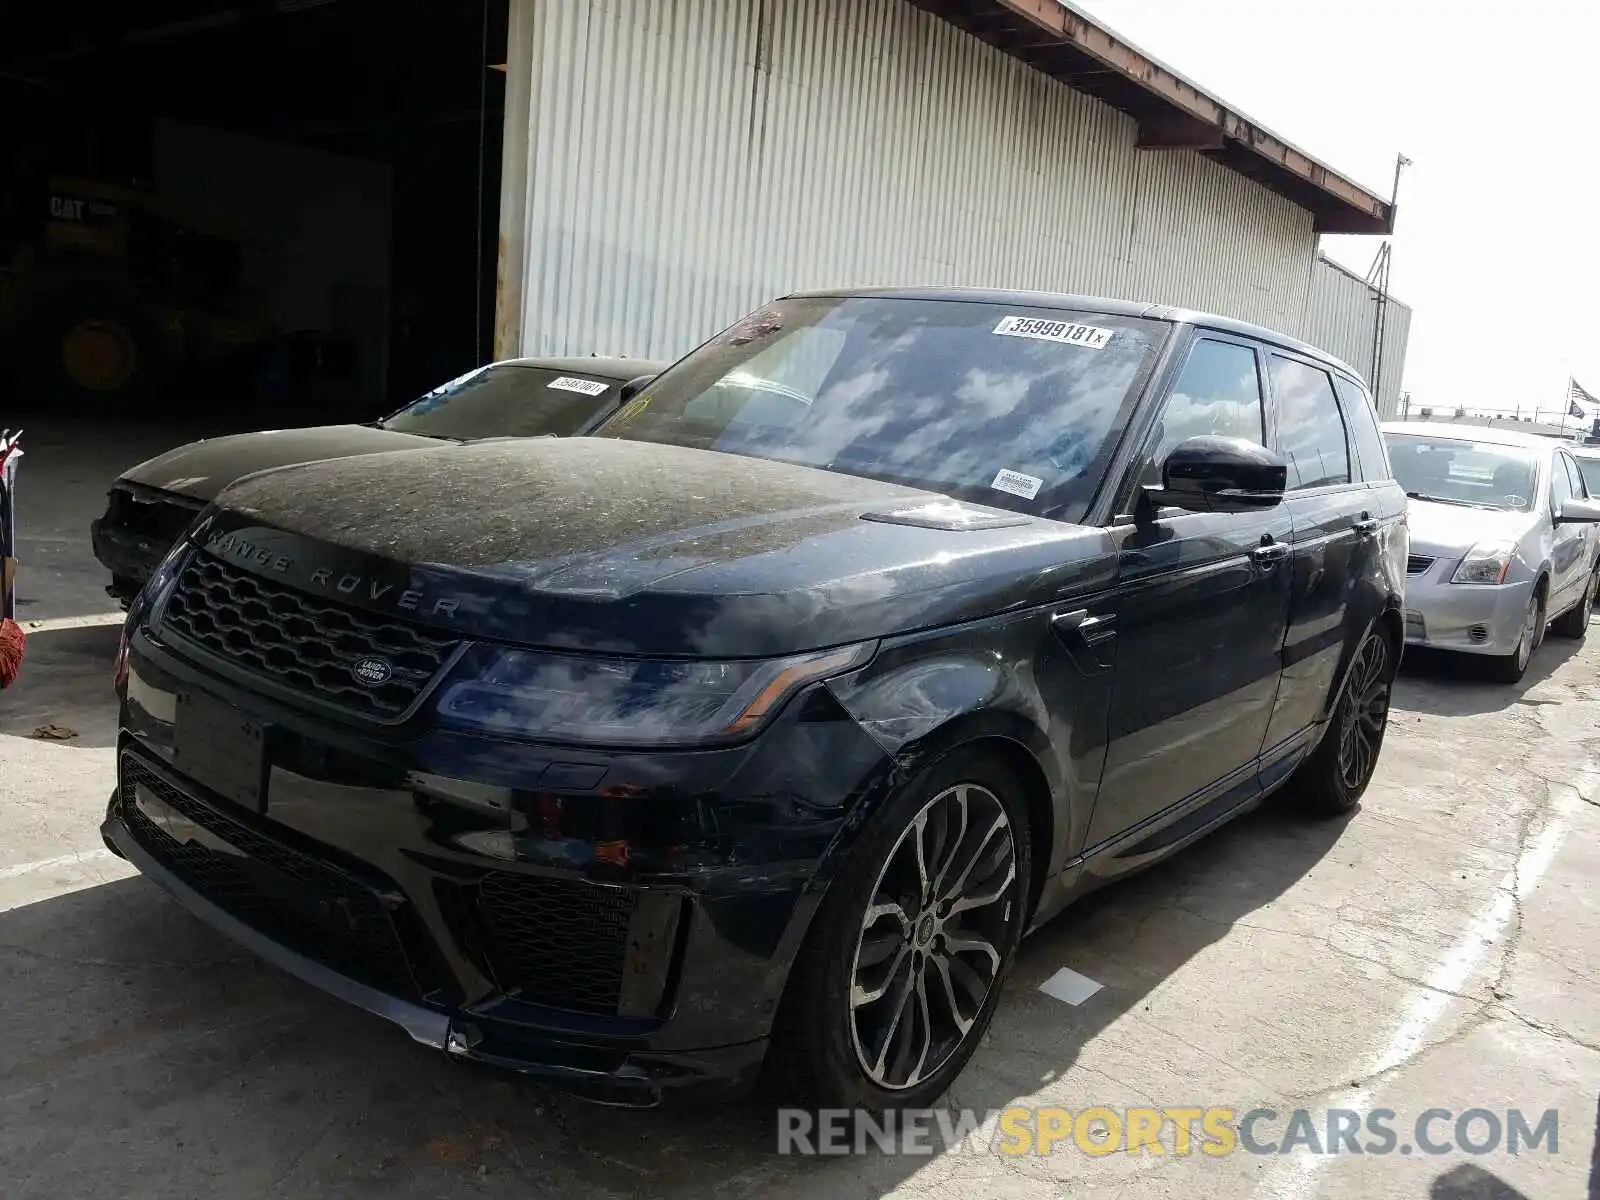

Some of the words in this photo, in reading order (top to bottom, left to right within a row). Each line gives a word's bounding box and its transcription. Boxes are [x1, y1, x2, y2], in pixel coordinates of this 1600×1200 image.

[49, 196, 85, 221] CAT
[207, 529, 295, 573] RANGE
[310, 566, 461, 619] ROVER
[359, 668, 385, 681] ROVER
[361, 660, 382, 671] LAND
